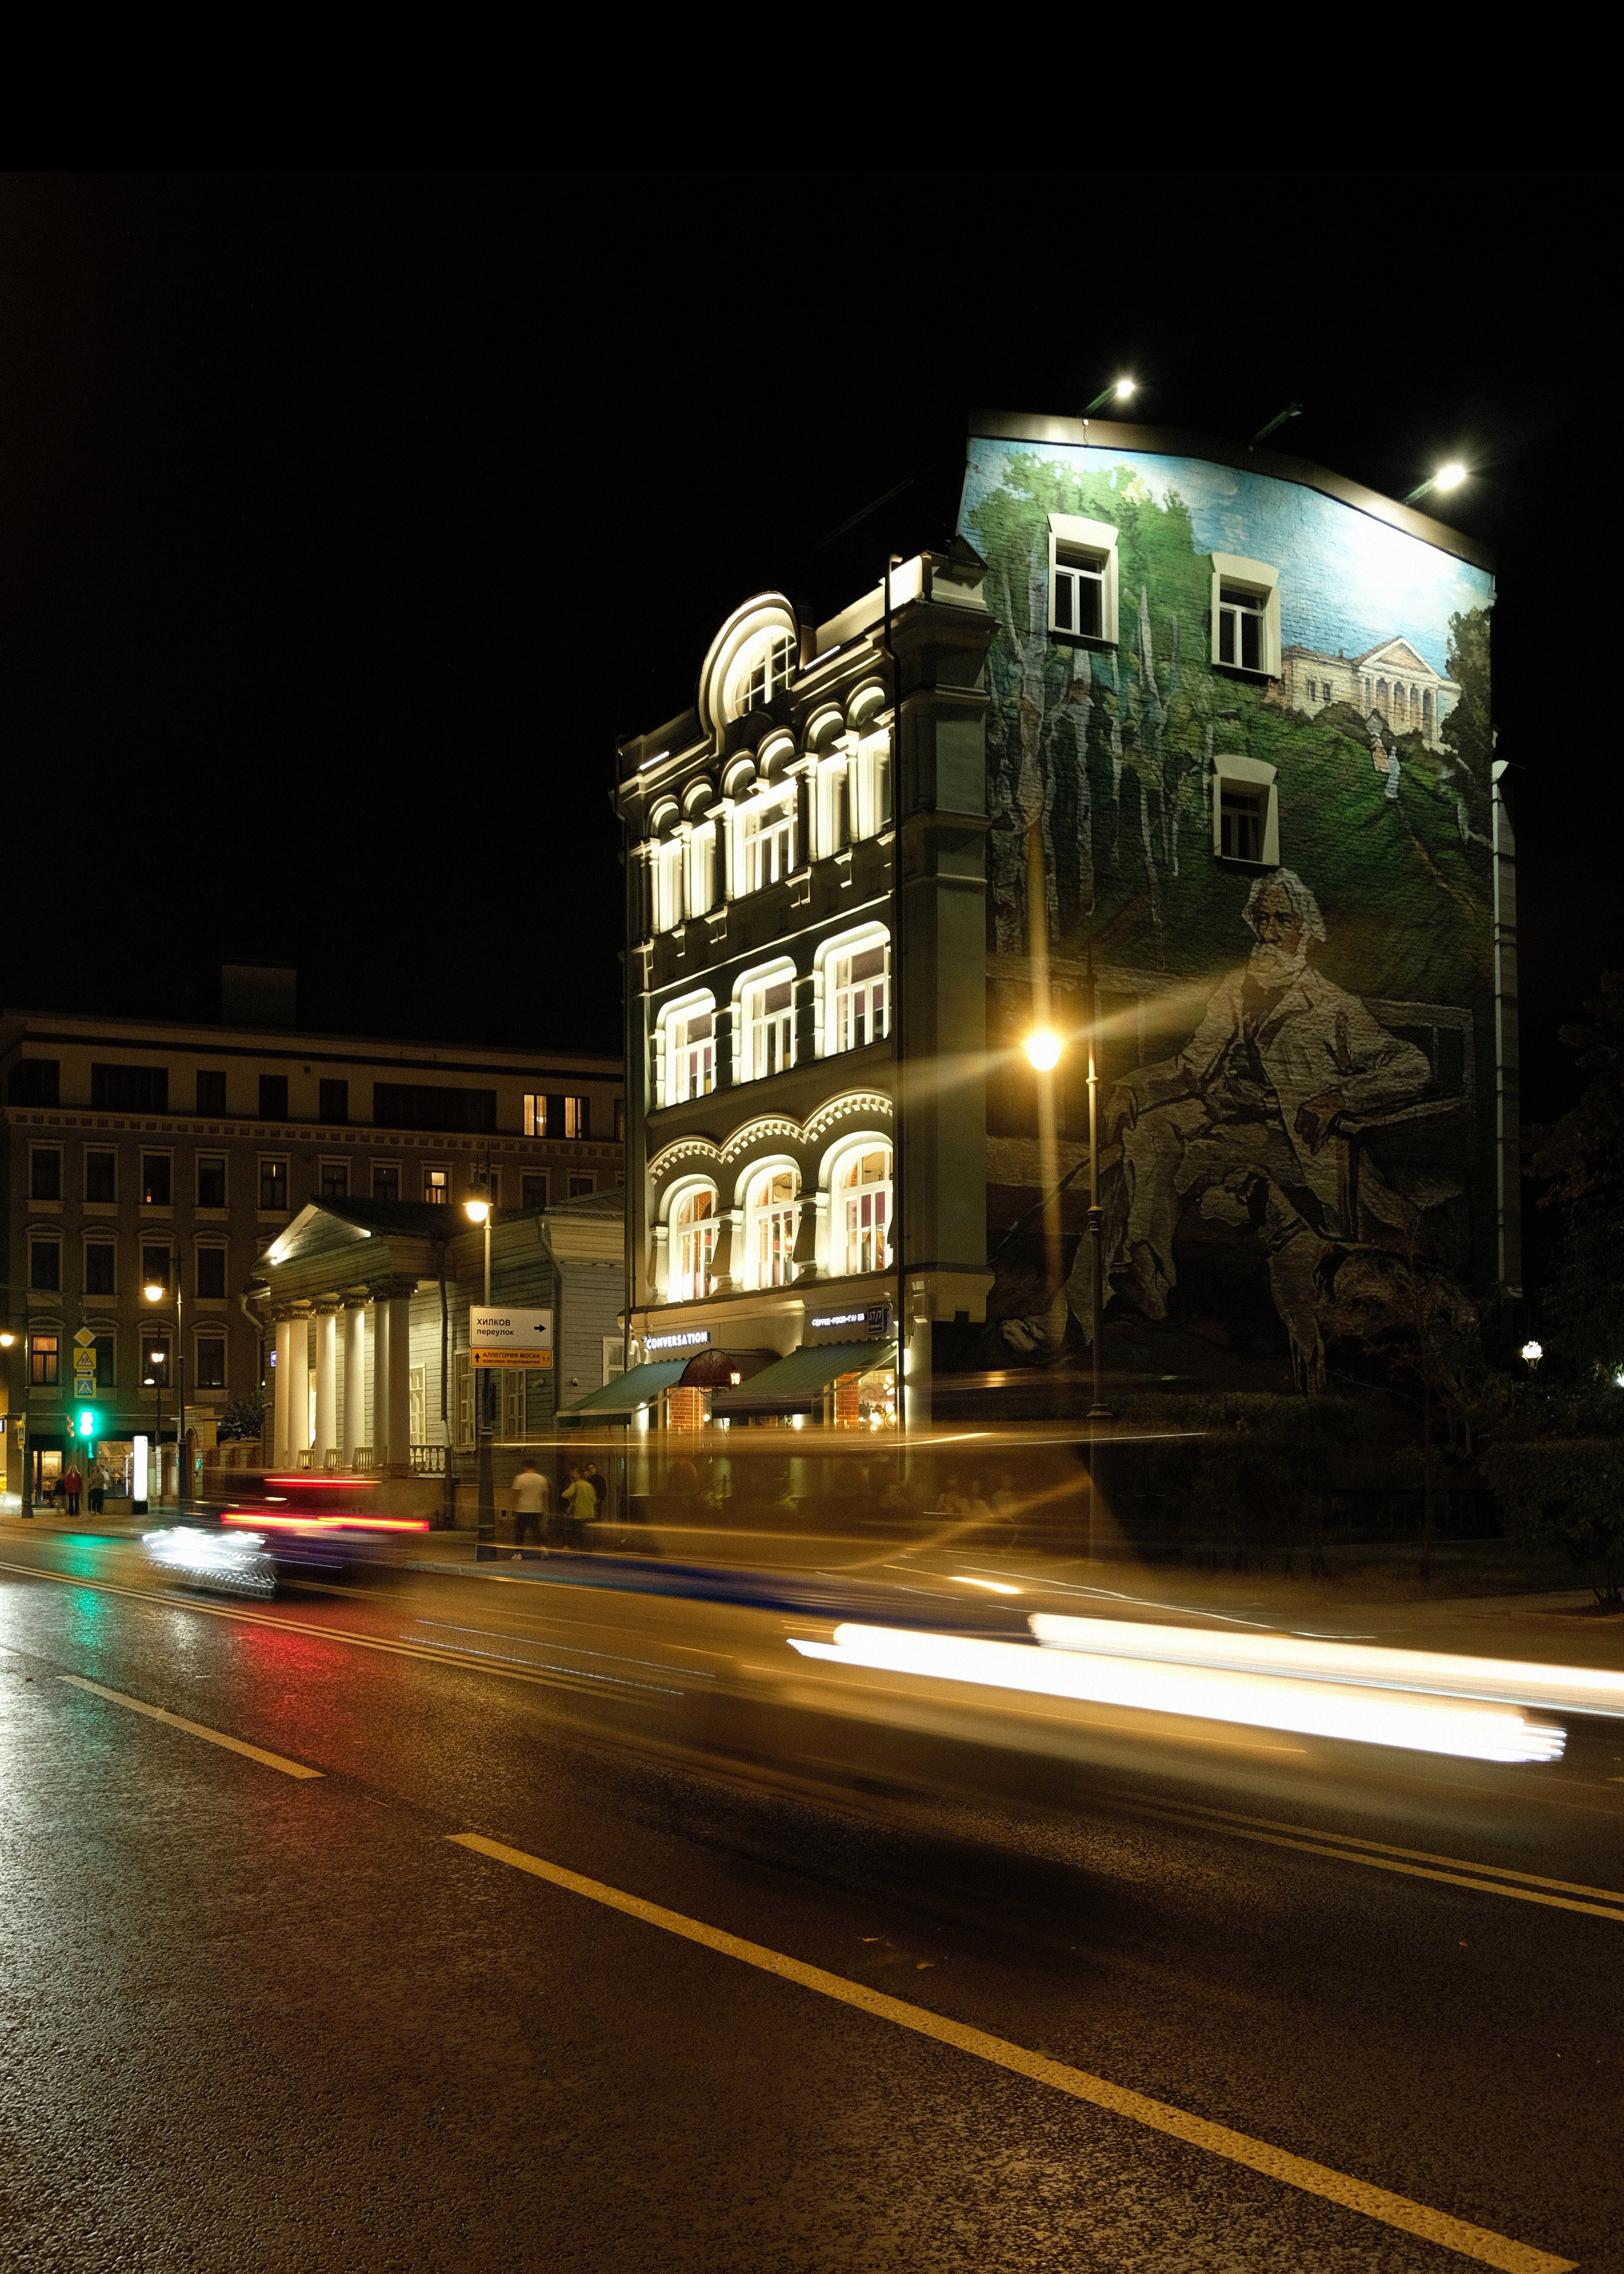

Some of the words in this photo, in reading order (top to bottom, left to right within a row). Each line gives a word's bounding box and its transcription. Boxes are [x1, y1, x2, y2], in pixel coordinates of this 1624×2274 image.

[812, 1318, 830, 1327] COFFEE
[833, 1316, 846, 1324] FOOD
[868, 1310, 882, 1322] 37/7
[646, 1331, 707, 1350] CONVERSATION
